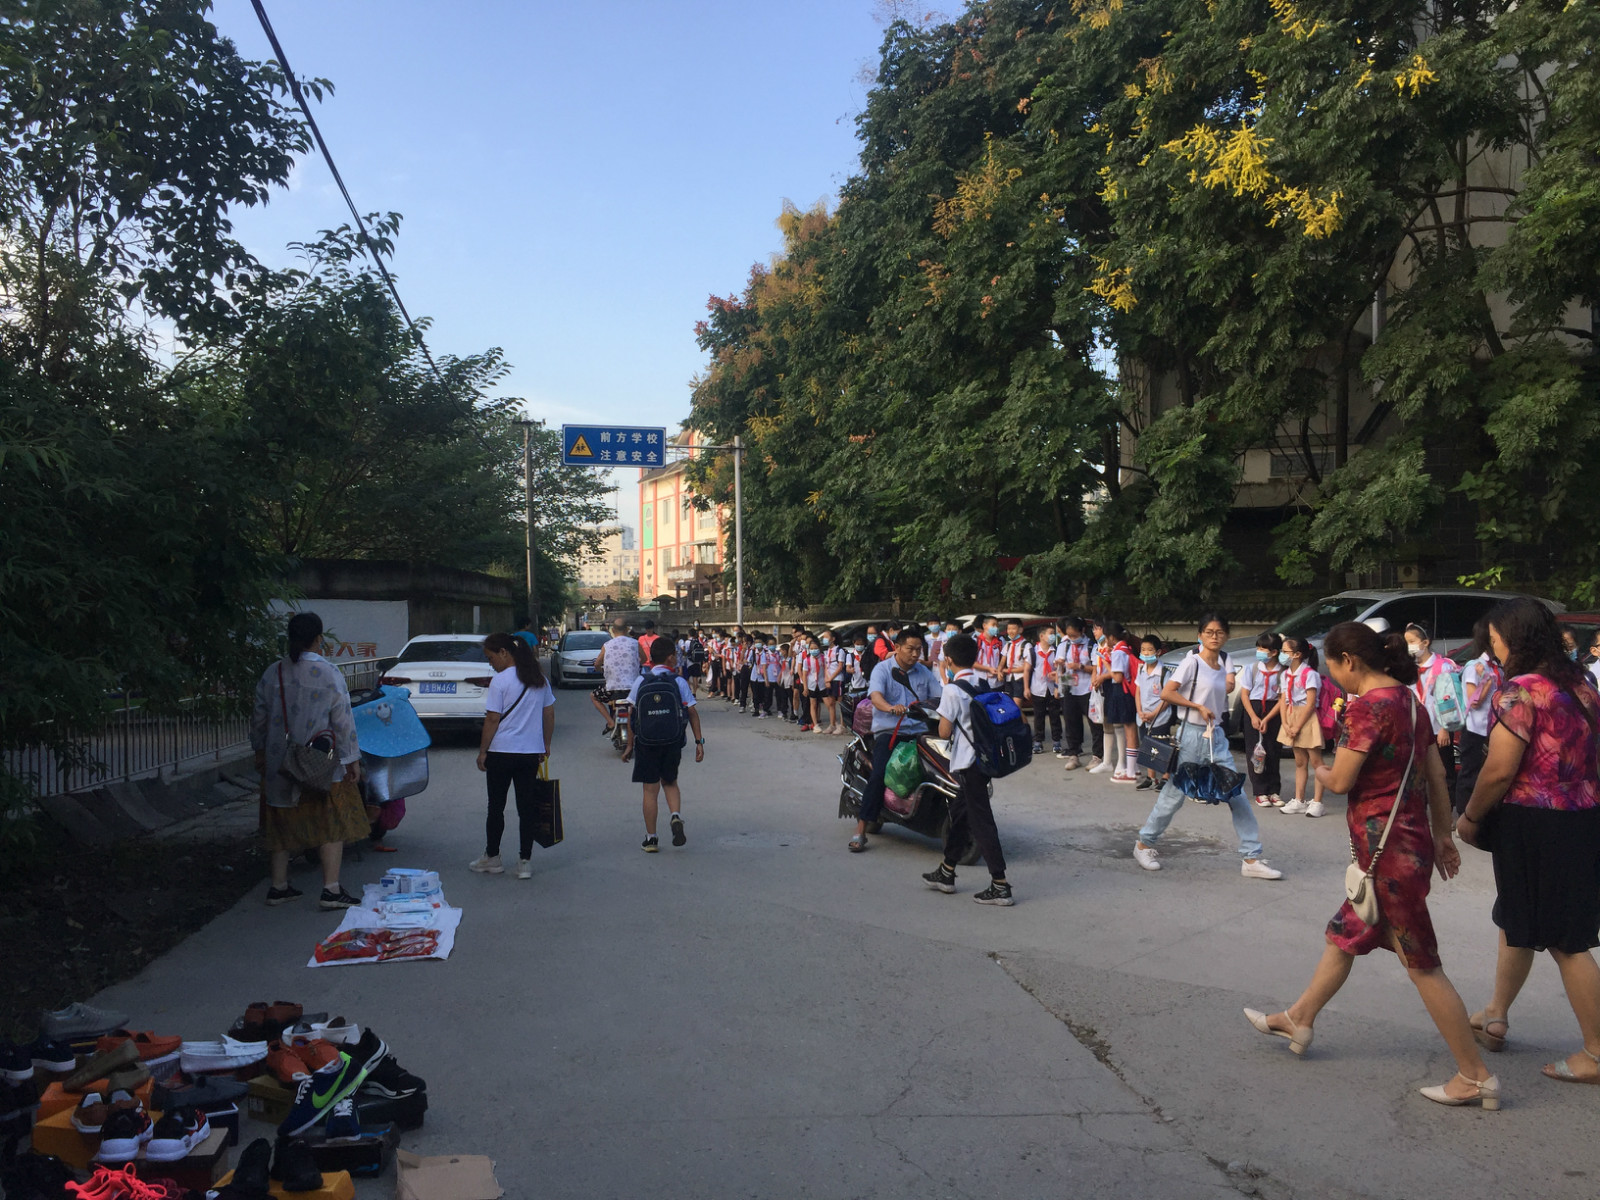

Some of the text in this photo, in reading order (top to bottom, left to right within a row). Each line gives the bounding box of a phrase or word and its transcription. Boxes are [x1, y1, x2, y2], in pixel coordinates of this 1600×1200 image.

[600, 431, 658, 444] 前方学校
[600, 449, 658, 462] 注意安全
